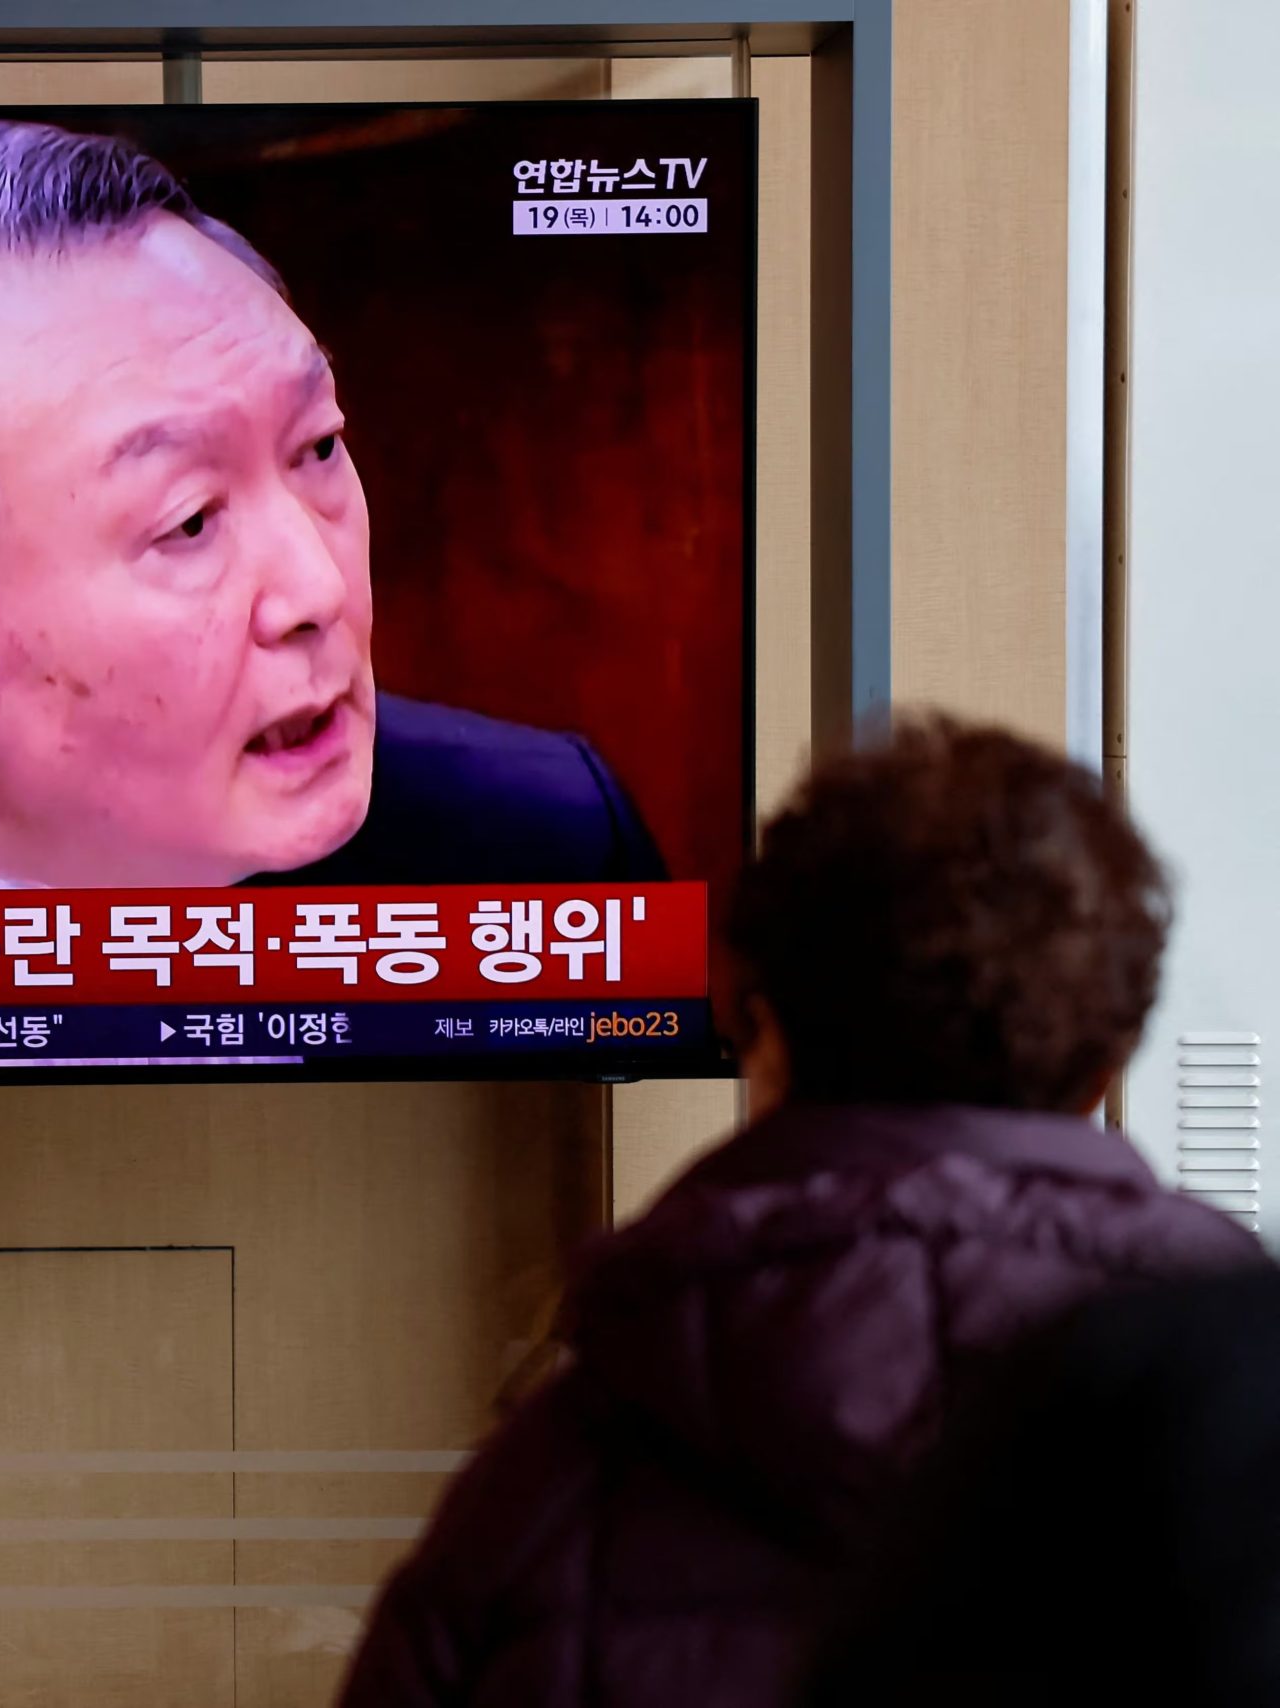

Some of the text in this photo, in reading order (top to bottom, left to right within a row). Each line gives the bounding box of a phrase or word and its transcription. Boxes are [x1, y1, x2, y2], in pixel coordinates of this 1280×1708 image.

[513, 157, 708, 194] 연합뉴스TV
[621, 204, 699, 228] 14:00
[470, 896, 646, 984] 행위'
[183, 1013, 244, 1046] 국힘
[434, 1011, 679, 1043] 제보 카카오톡/라인 jebo23
